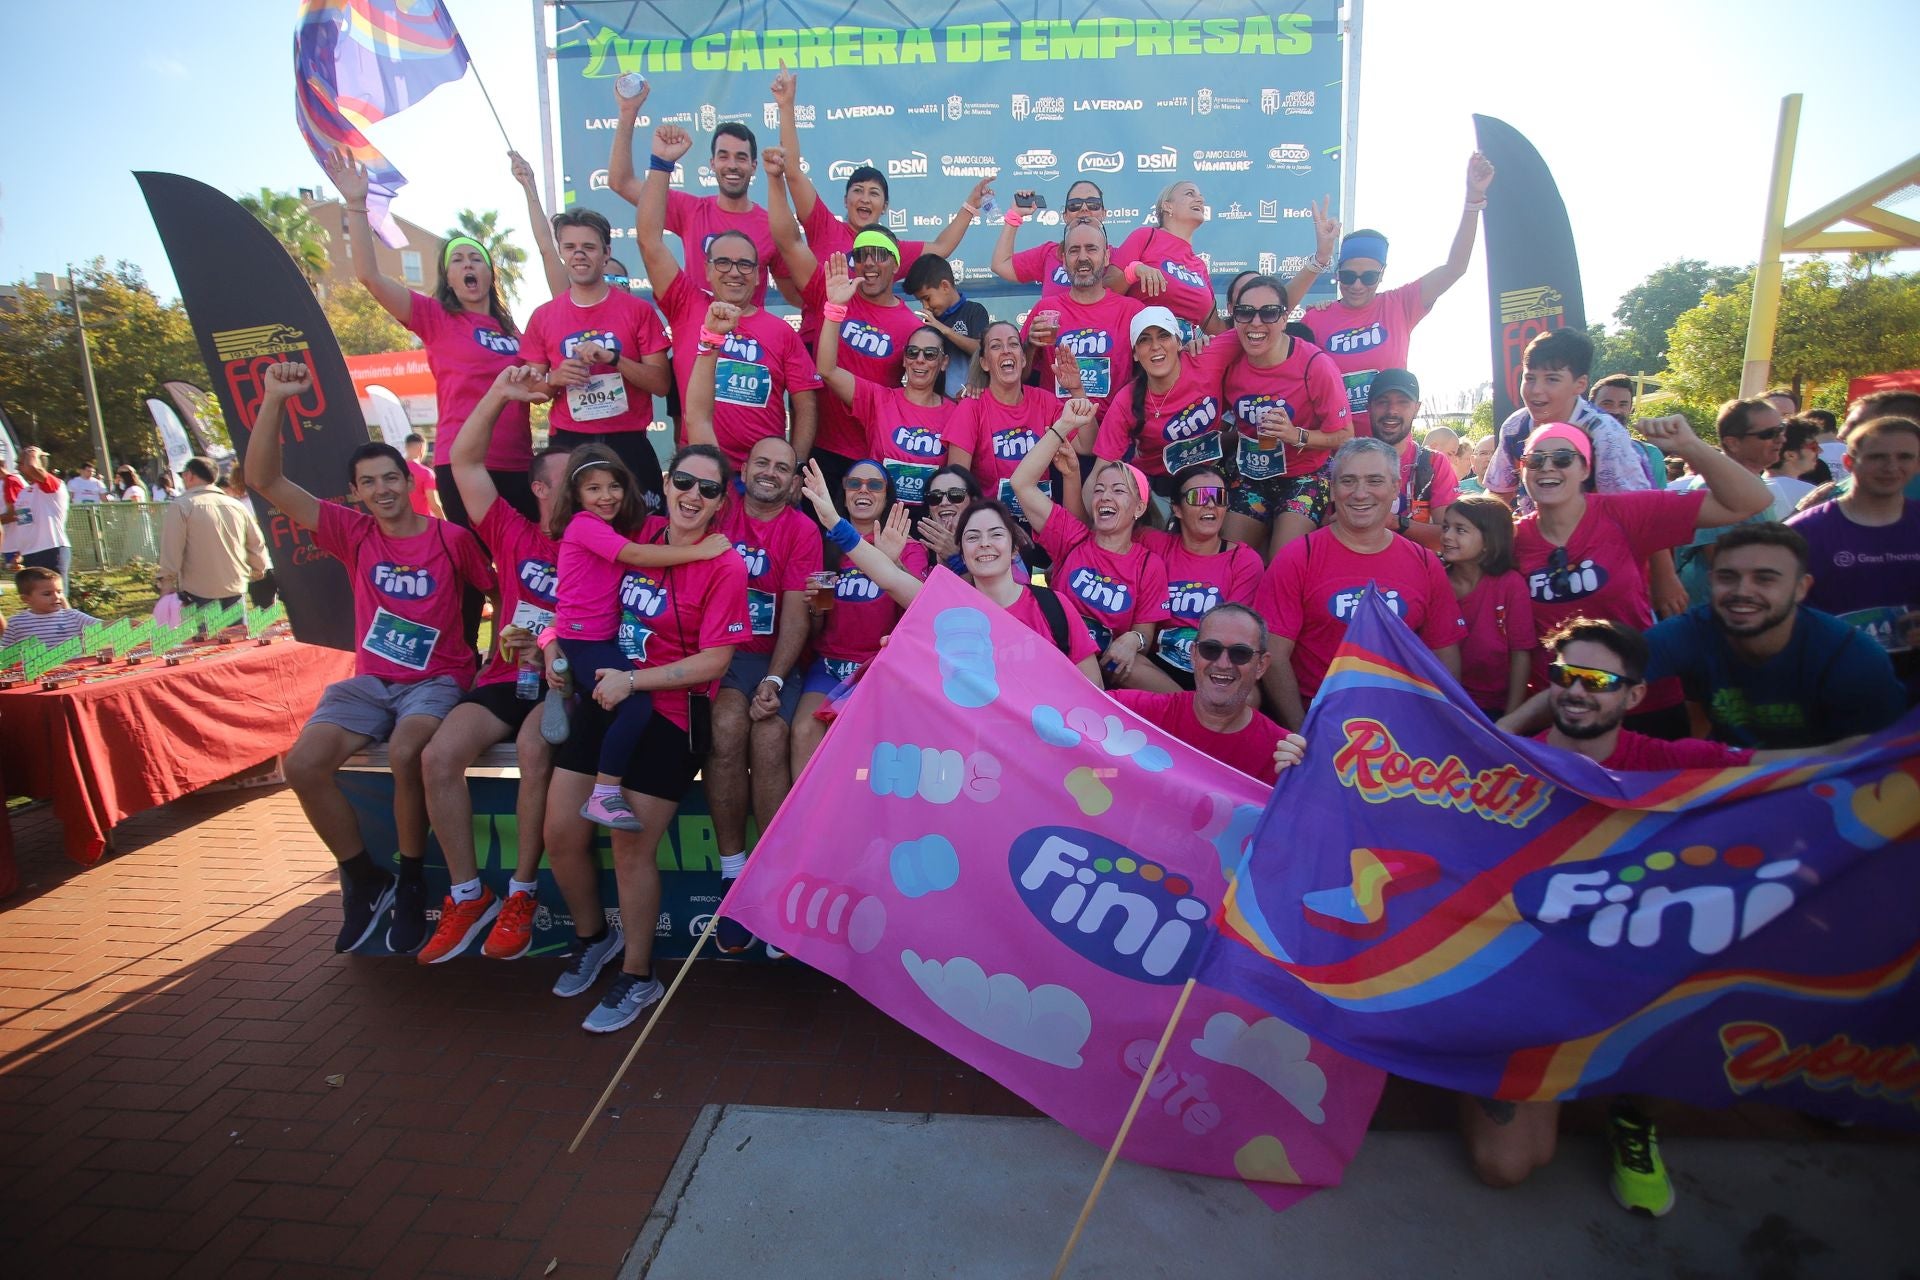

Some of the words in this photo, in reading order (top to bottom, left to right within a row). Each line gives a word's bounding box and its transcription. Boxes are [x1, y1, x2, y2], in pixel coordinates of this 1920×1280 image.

[612, 38, 685, 72] VII
[691, 26, 937, 71] CARRERA
[946, 20, 1011, 63] DE
[1019, 12, 1313, 62] EMPRESAS
[601, 115, 650, 129] VEAD
[888, 158, 928, 175] DSM
[1085, 157, 1118, 168] VIDAL
[1137, 153, 1177, 169] DSM
[913, 215, 943, 226] Hero
[1166, 260, 1205, 288] Fini
[724, 331, 758, 362] ini
[842, 321, 891, 357] Fini
[1330, 321, 1381, 352] Fini
[727, 373, 759, 390] 410
[1079, 369, 1098, 382] 22
[578, 390, 616, 407] 2094
[1166, 395, 1217, 441] Fini
[895, 427, 942, 455] Fini
[992, 428, 1036, 458] Fini
[895, 474, 924, 490] 429
[375, 565, 428, 597] Fini
[520, 561, 559, 596] Fin
[1072, 569, 1128, 612] Fini
[619, 574, 668, 617] Fini
[385, 627, 419, 650] 414
[1019, 835, 1207, 977] Fini
[1537, 858, 1801, 955] Fini
